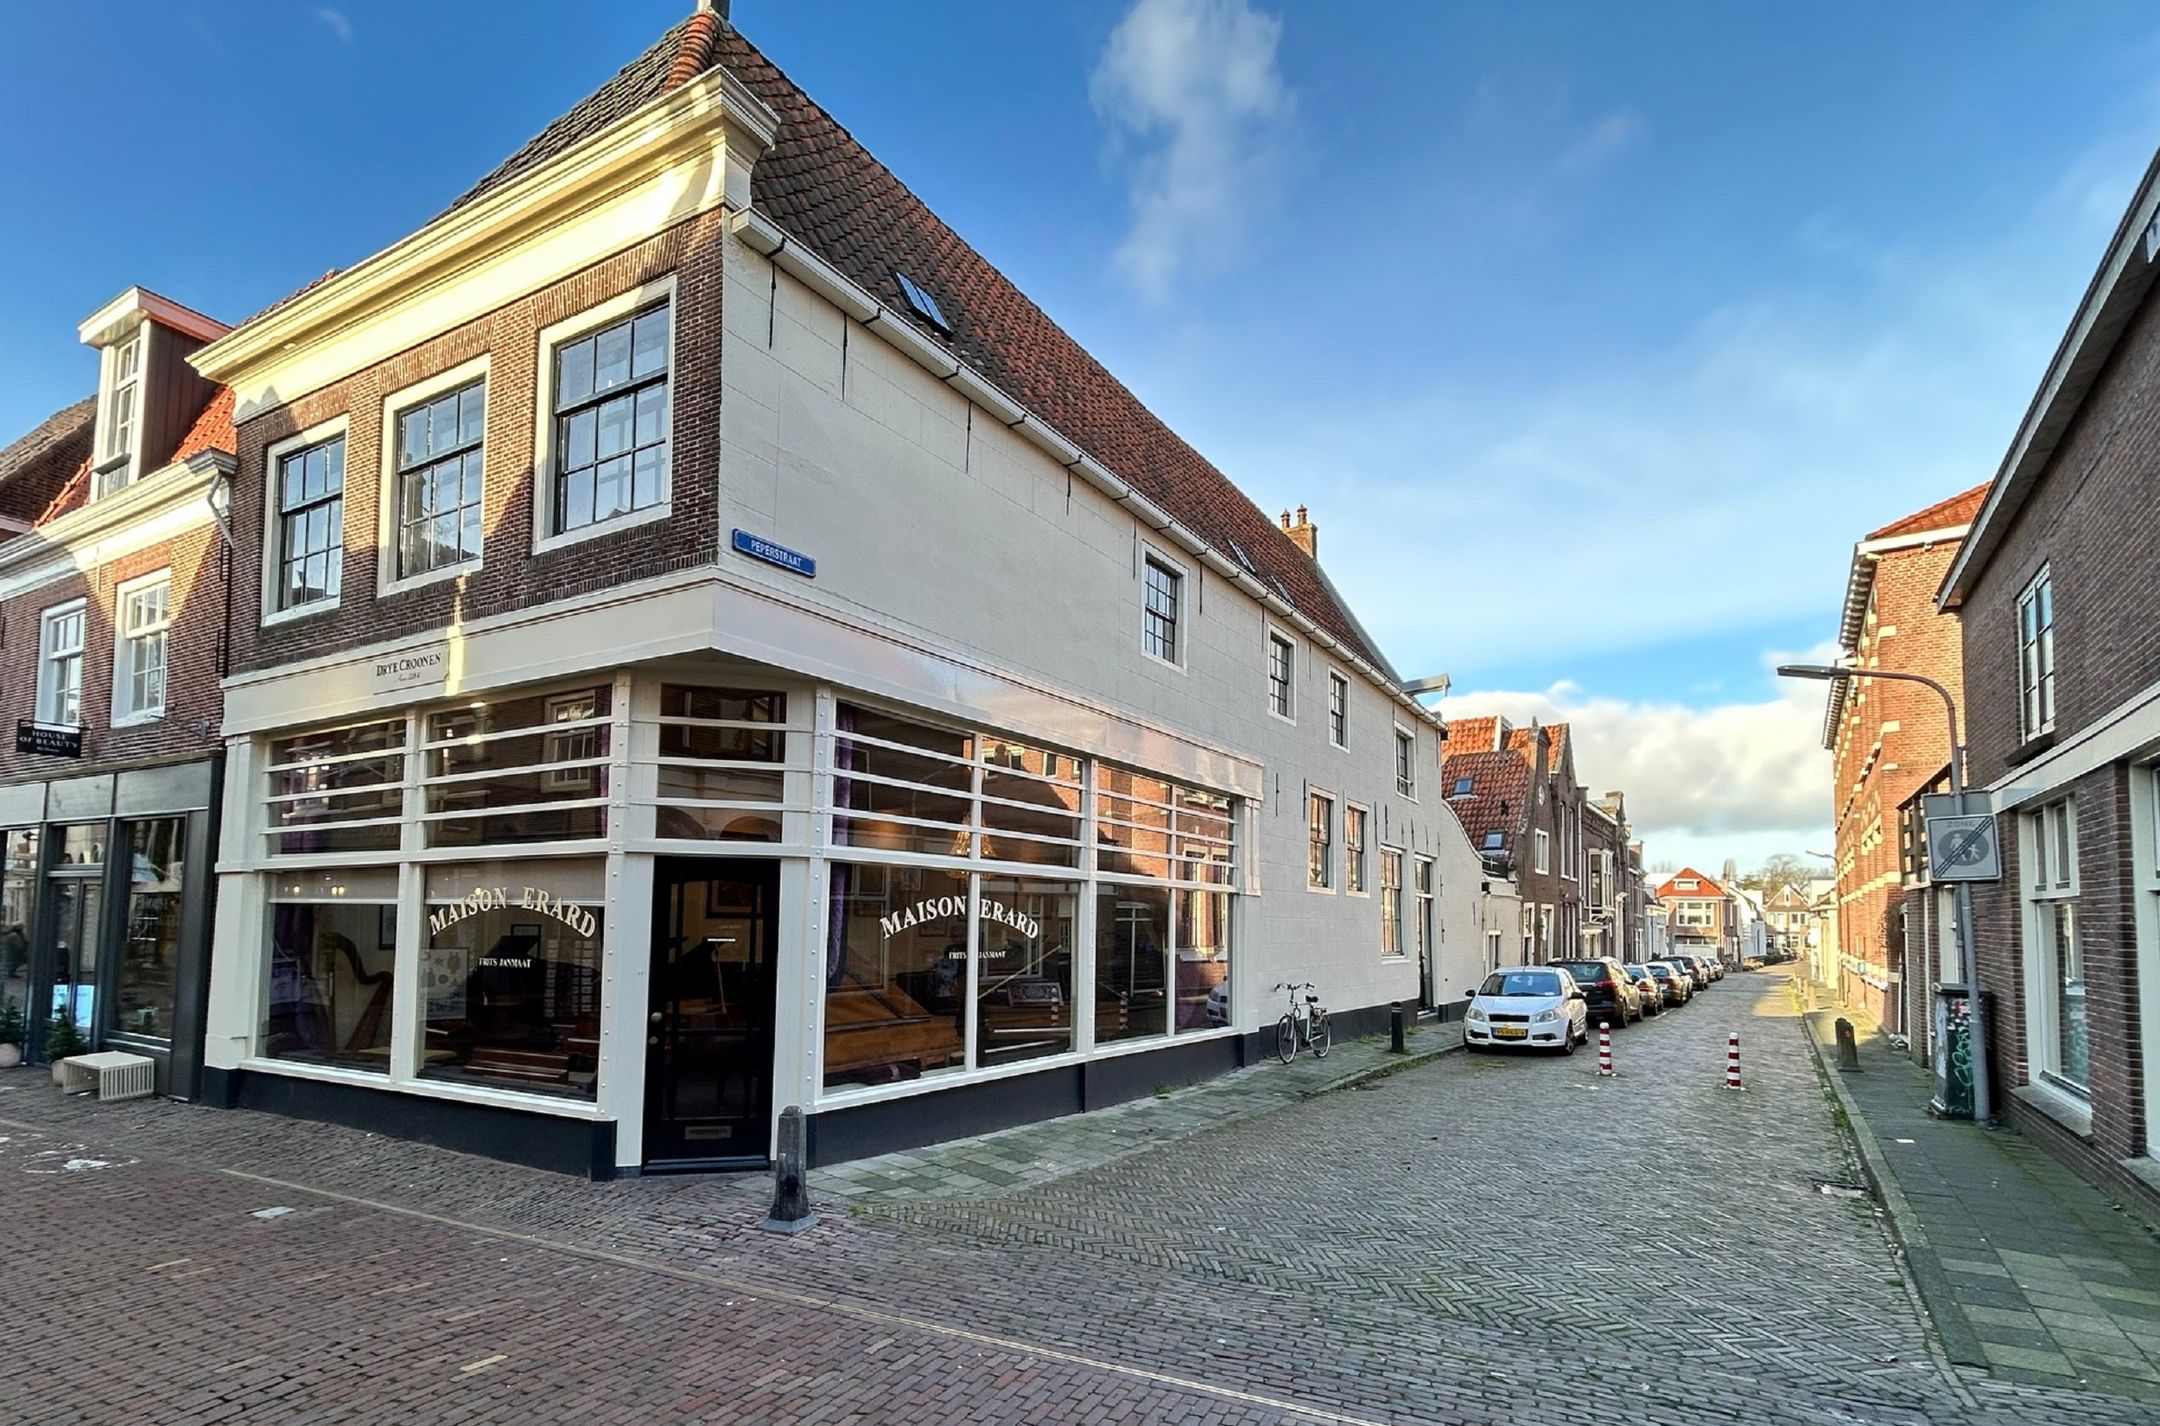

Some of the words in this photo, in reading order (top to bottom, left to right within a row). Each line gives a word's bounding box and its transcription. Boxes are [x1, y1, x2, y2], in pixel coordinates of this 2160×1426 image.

[750, 539, 802, 568] PEPERSTRAAT
[376, 662, 398, 676] DRYE
[399, 653, 442, 671] CROONEN
[19, 736, 32, 744] OF
[36, 738, 79, 748] BEAUTY
[32, 730, 66, 740] HOUSE
[429, 887, 508, 936] MAISON
[520, 886, 597, 938] ERARD
[879, 895, 967, 939] MAISON
[979, 898, 1039, 939] ERARD
[479, 957, 498, 967] FRITS
